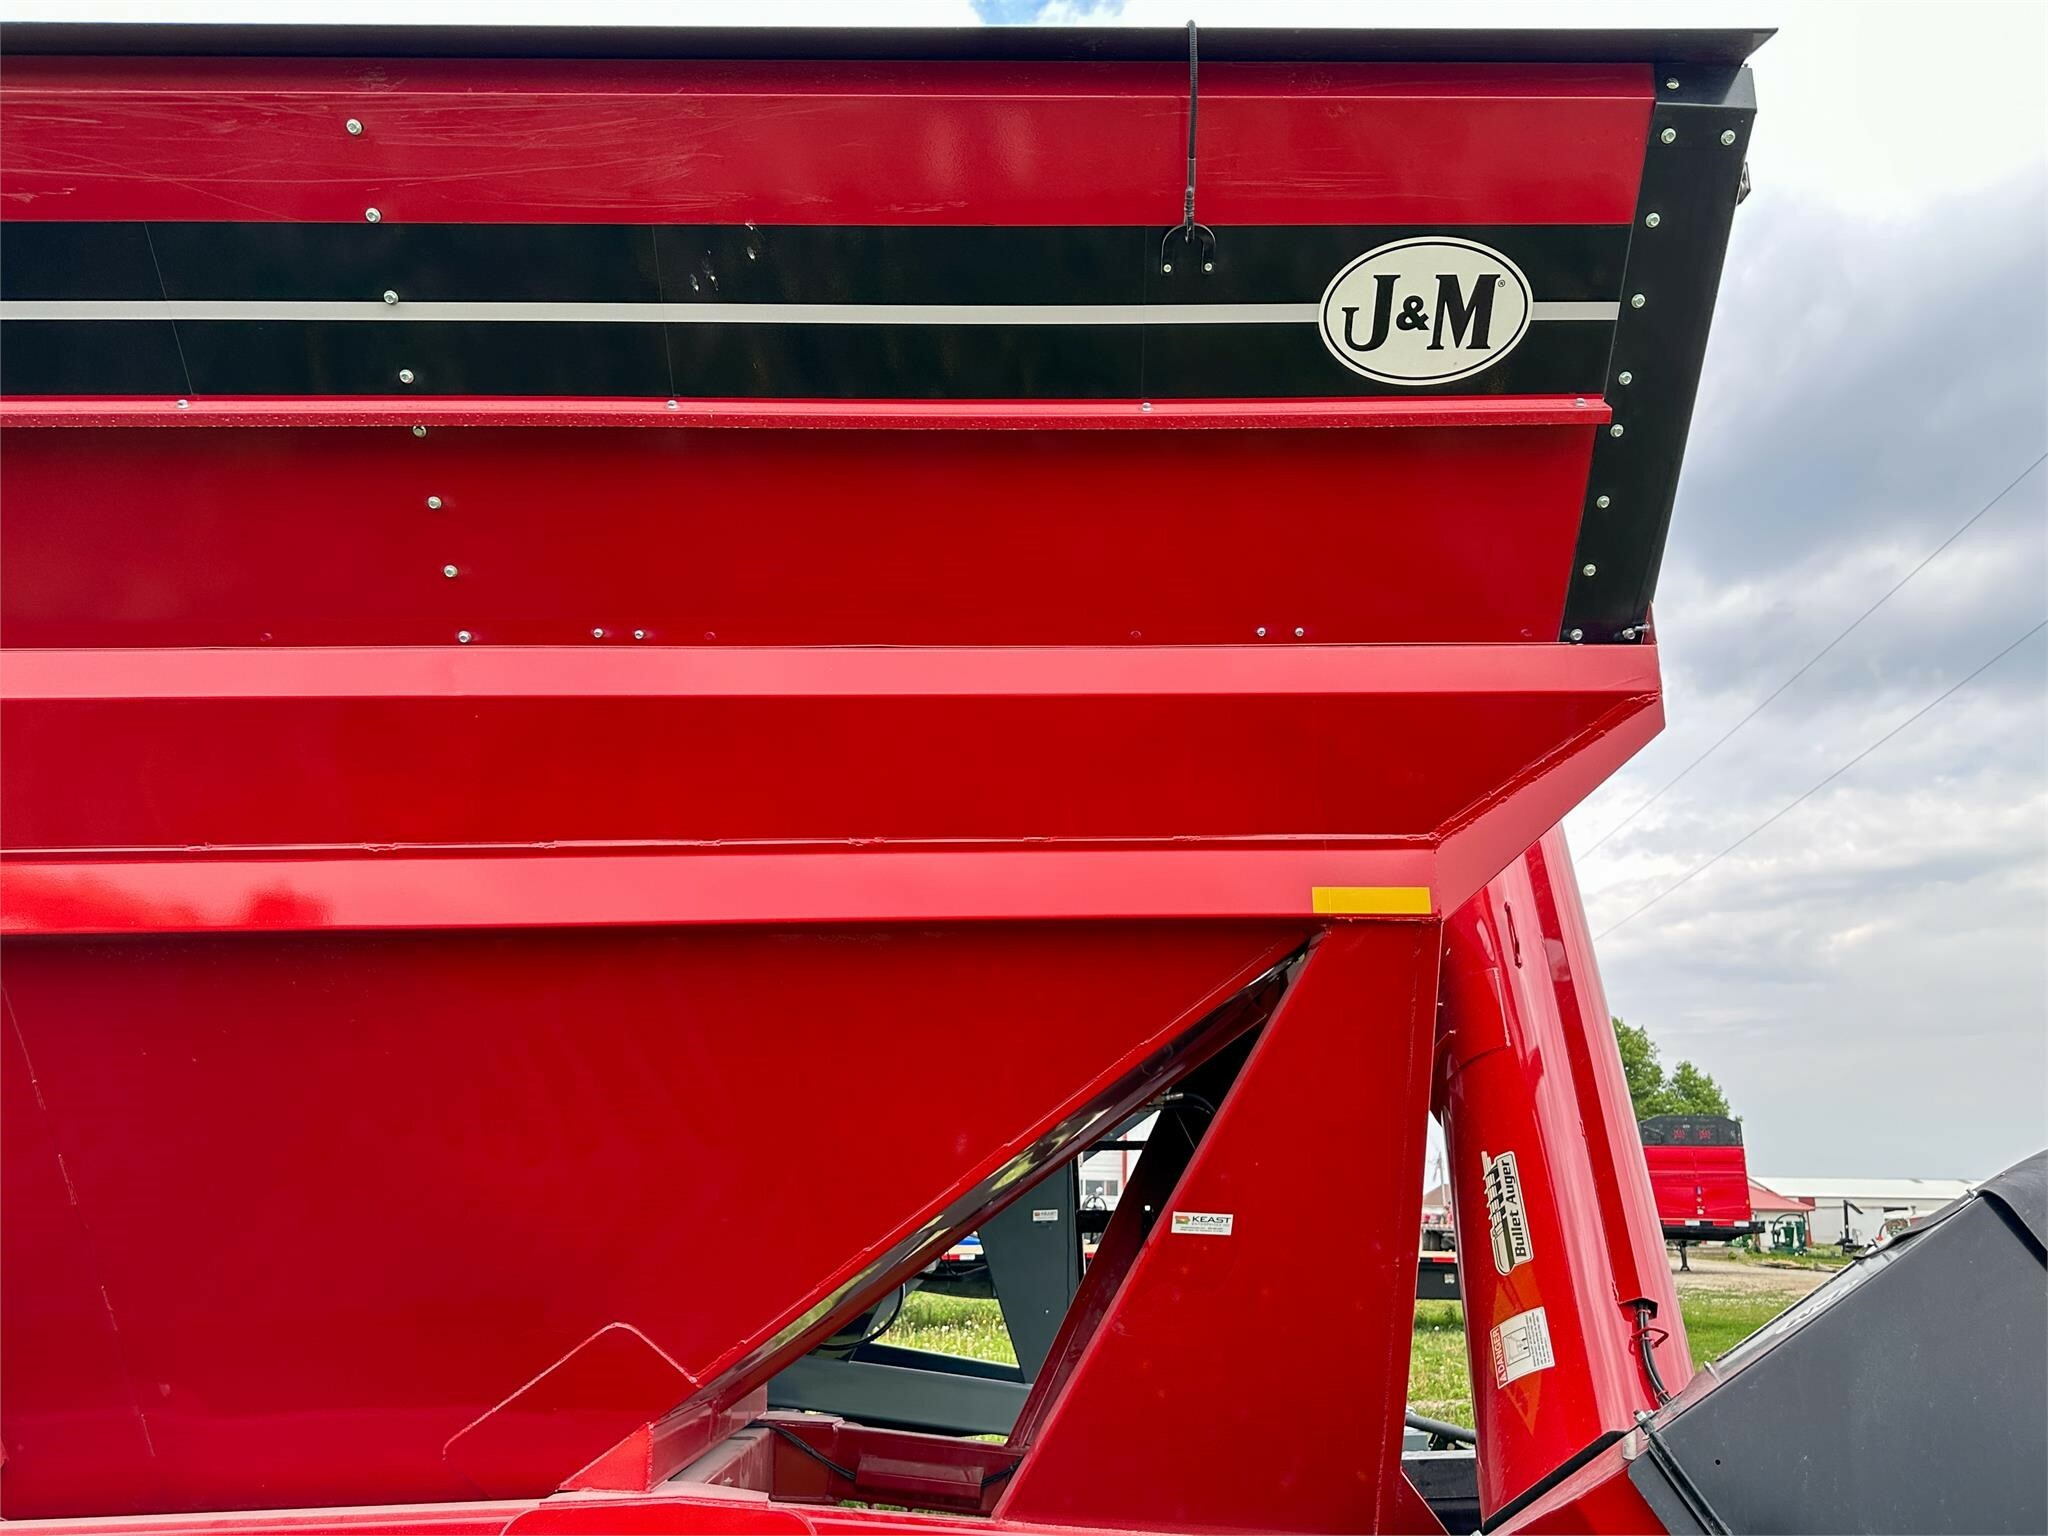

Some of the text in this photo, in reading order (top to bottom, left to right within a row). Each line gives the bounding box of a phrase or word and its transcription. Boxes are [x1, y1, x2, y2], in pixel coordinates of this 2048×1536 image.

[1341, 273, 1501, 352] J&M
[1191, 1215, 1232, 1224] KEAST
[1501, 1160, 1527, 1257] Bullet Auger
[1491, 1328, 1506, 1374] DANGER
